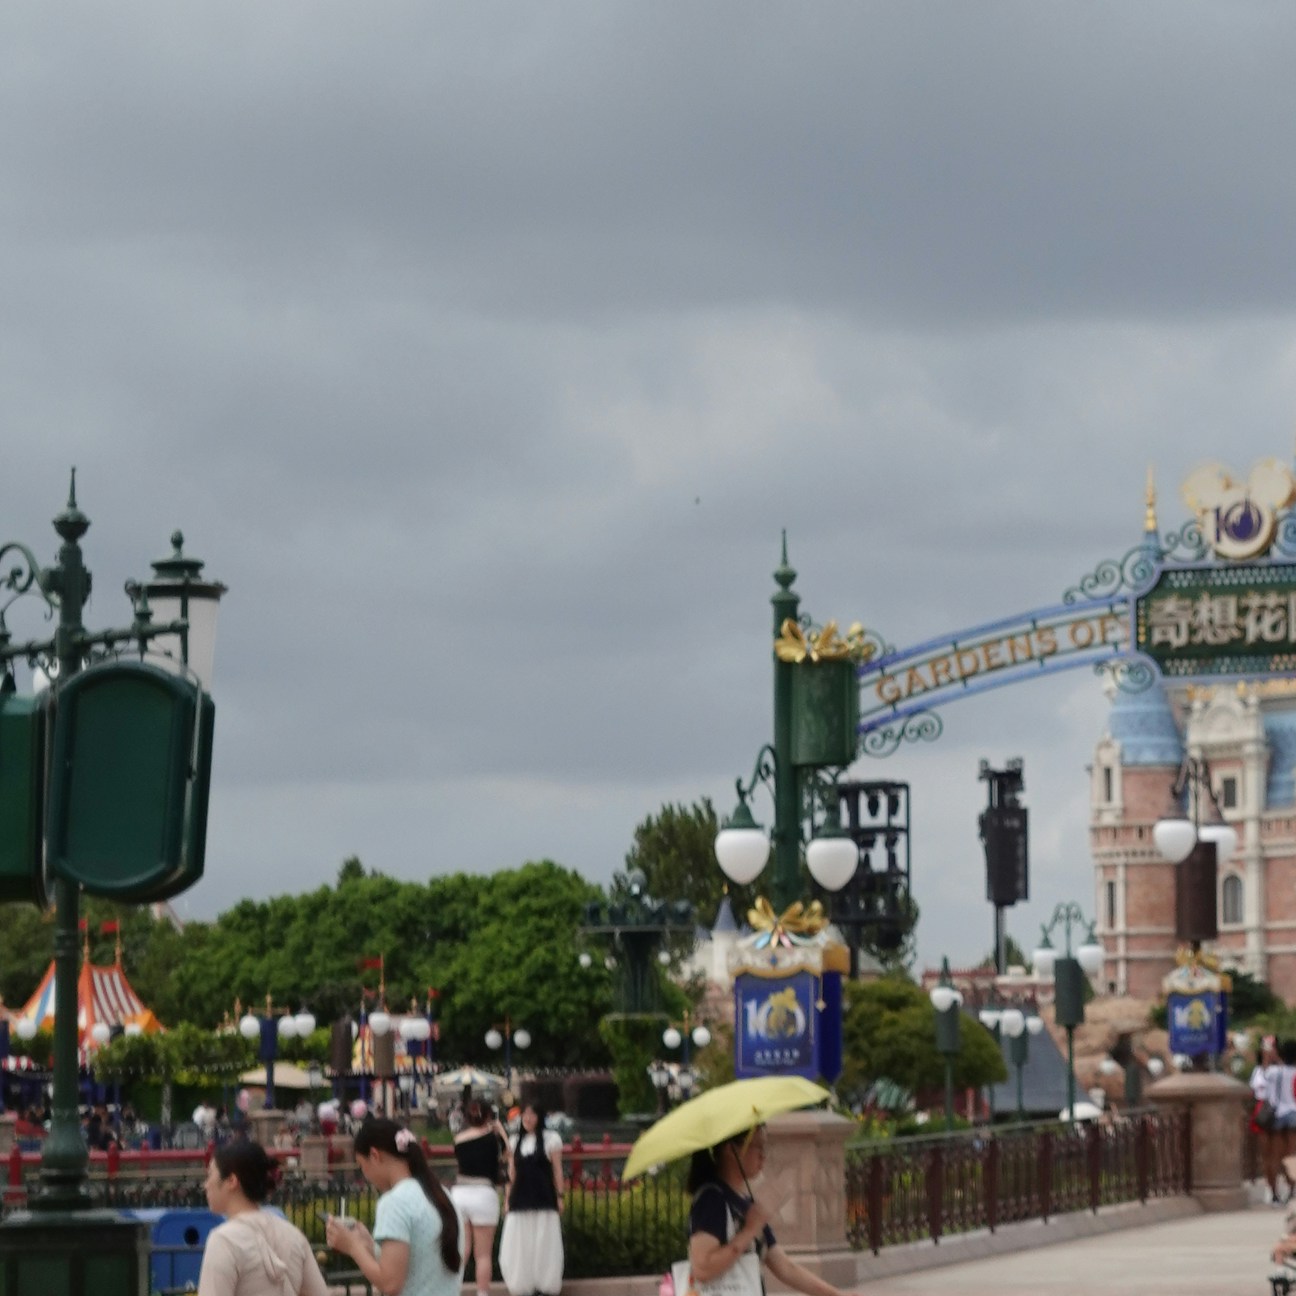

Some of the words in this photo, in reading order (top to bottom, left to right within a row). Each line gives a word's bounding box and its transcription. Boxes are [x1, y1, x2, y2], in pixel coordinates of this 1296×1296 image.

[1214, 500, 1263, 543] 10
[874, 625, 1059, 705] GARDENS
[1067, 613, 1119, 649] OF
